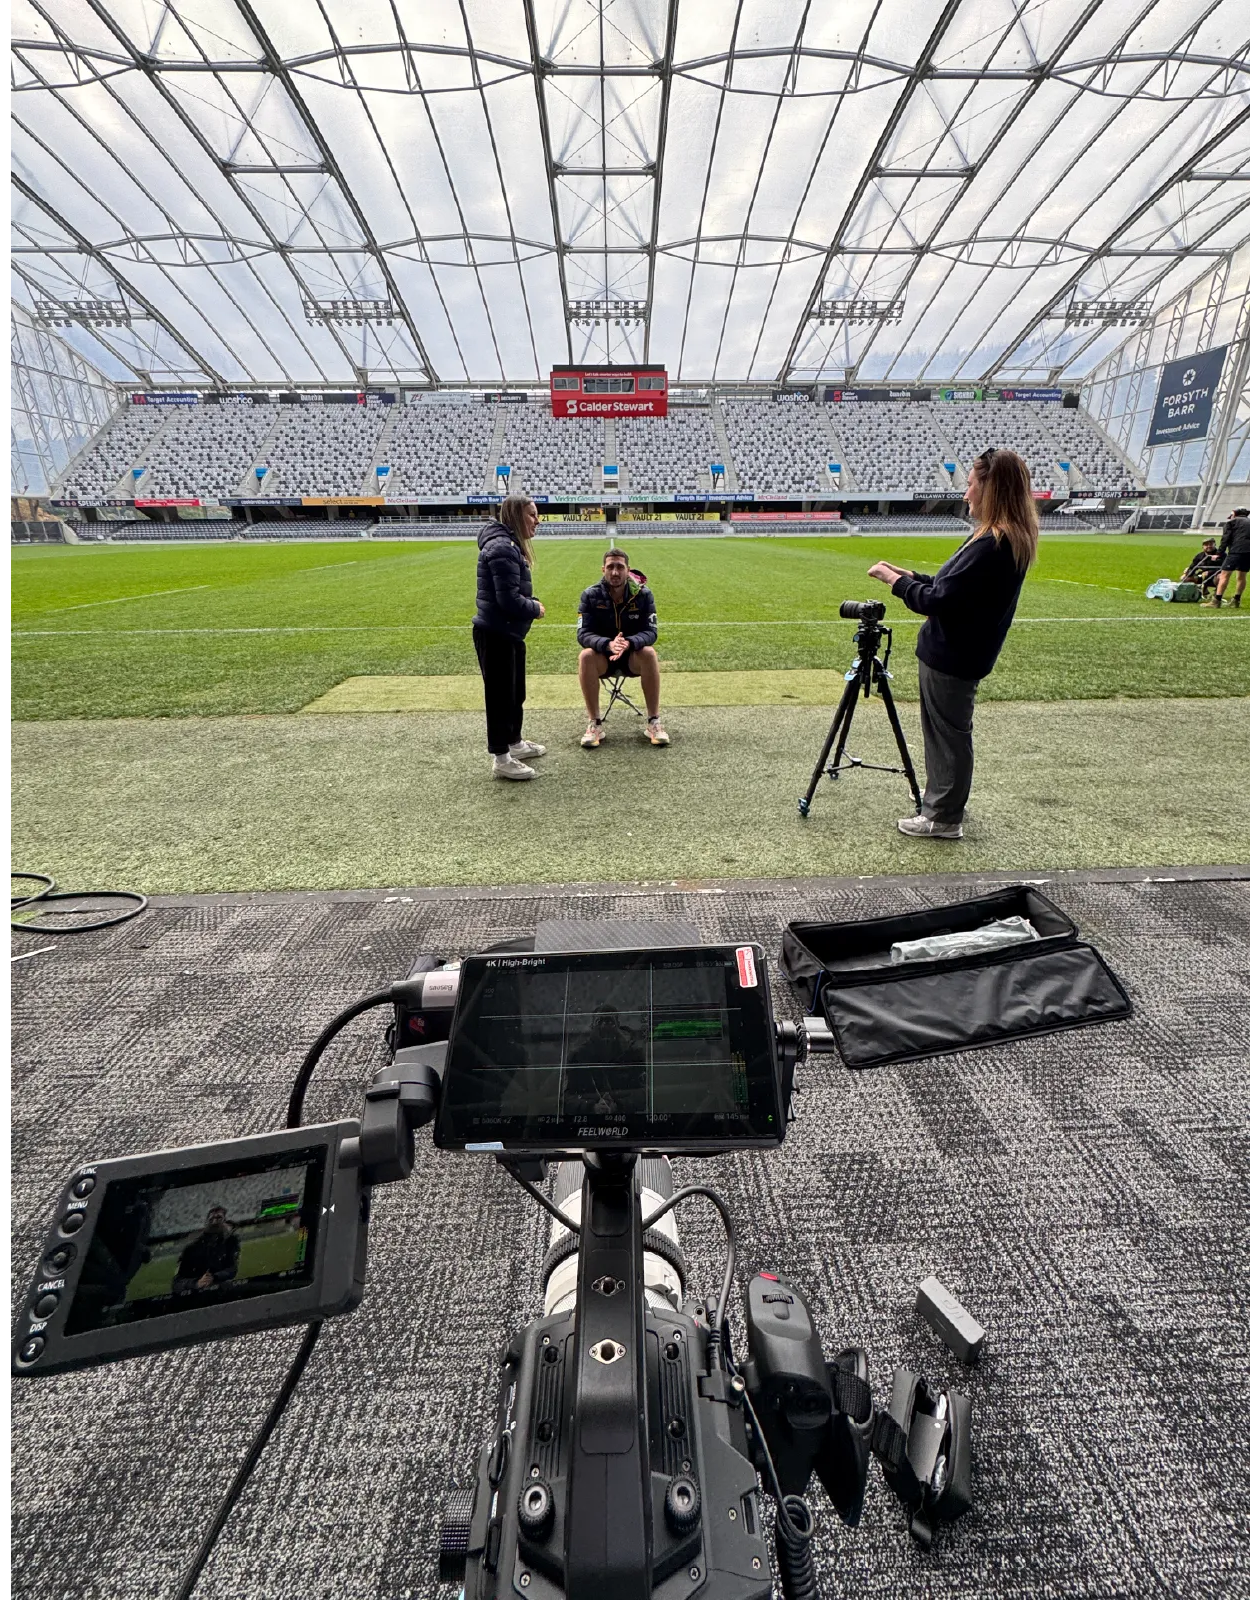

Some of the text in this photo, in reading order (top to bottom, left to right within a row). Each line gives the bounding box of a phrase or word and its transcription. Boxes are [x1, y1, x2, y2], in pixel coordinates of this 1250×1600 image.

[134, 395, 198, 404] TA Target Accounting
[219, 396, 253, 404] washco
[776, 392, 809, 402] washco
[1002, 391, 1014, 399] TA
[1032, 391, 1061, 399] Accounting
[1162, 387, 1209, 408] FORSYTH
[579, 402, 654, 412] Calder Stewart
[1167, 404, 1195, 418] BARR
[1155, 422, 1200, 435] Investment Advice
[323, 497, 342, 505] select
[542, 514, 549, 522] 21
[486, 957, 546, 968] 4K High-Bright
[577, 1126, 629, 1137] FEELWORLD
[80, 1166, 97, 1175] FUNC
[67, 1200, 88, 1210] MENU
[37, 1279, 65, 1292] CANCEL
[29, 1322, 47, 1333] DISP
[28, 1344, 36, 1355] 2
